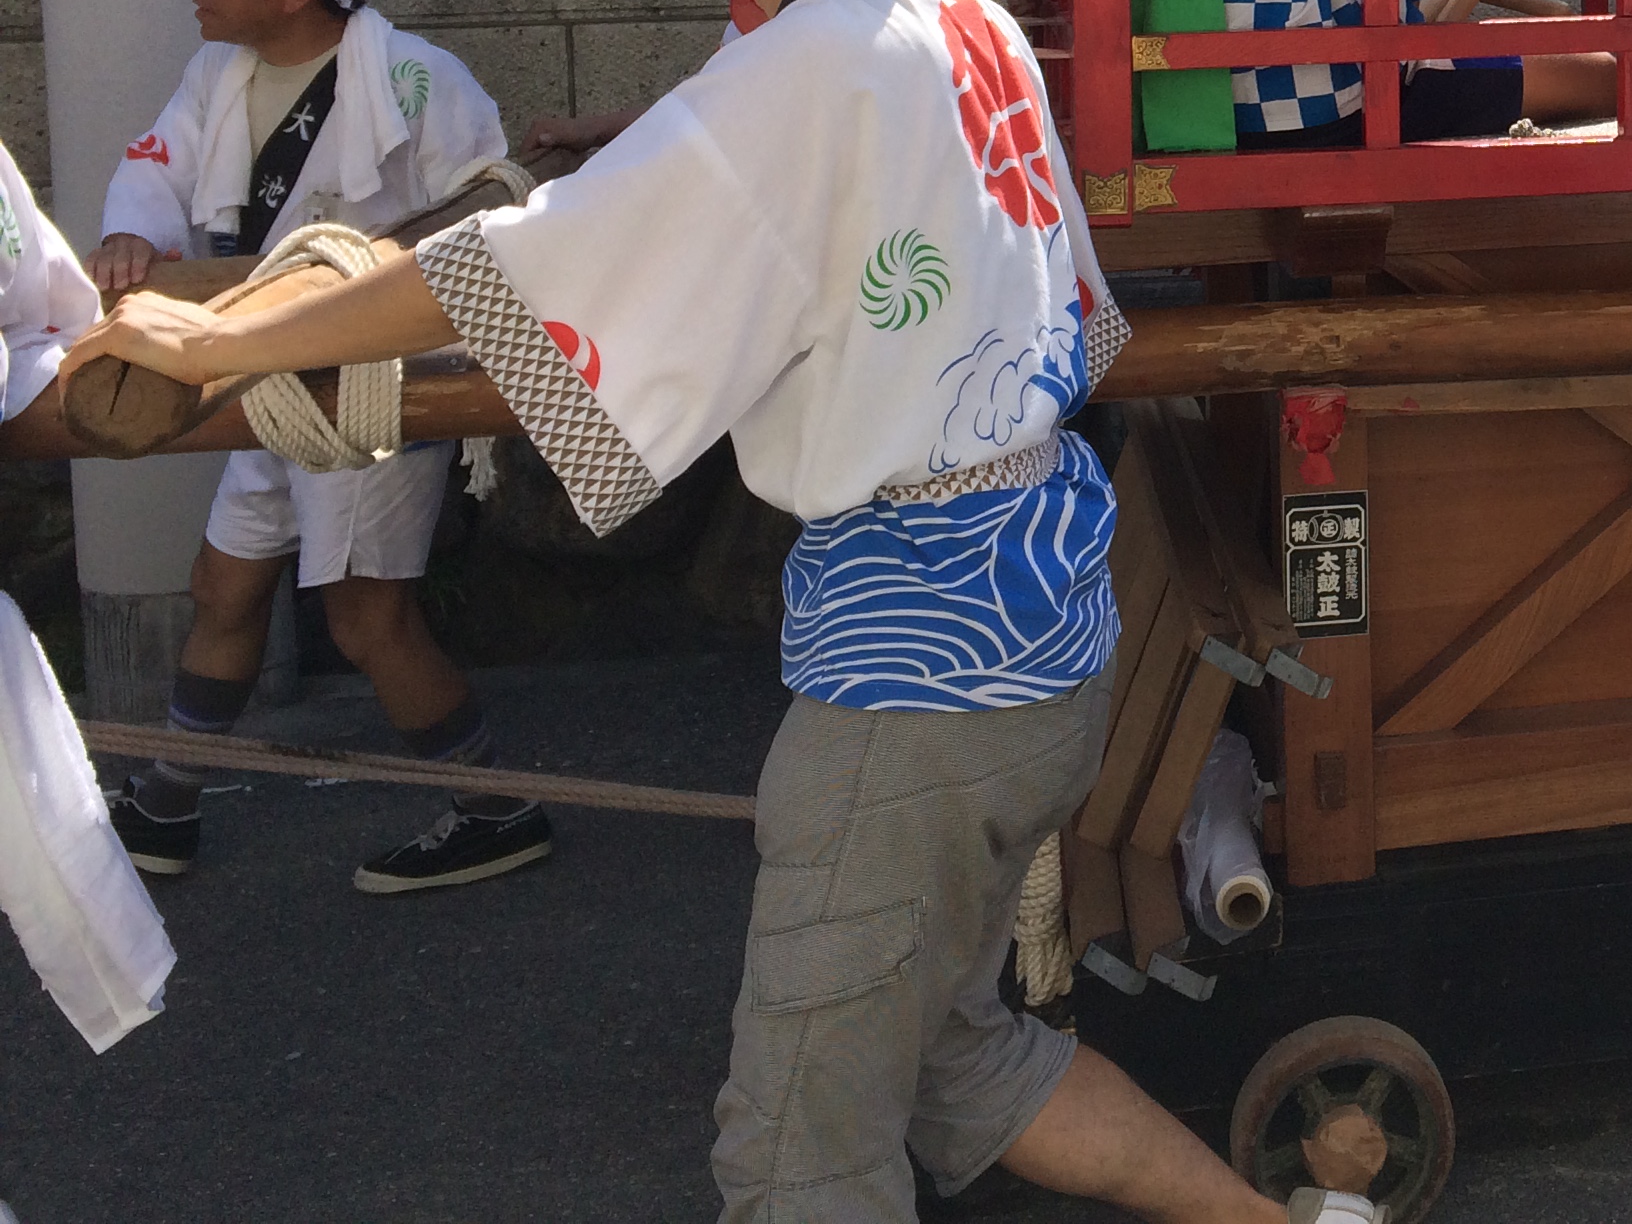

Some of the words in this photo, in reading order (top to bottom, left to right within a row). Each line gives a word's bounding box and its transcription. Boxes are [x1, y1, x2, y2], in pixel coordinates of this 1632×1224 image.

[257, 101, 322, 209] 大池
[1315, 550, 1342, 618] 太鼓正
